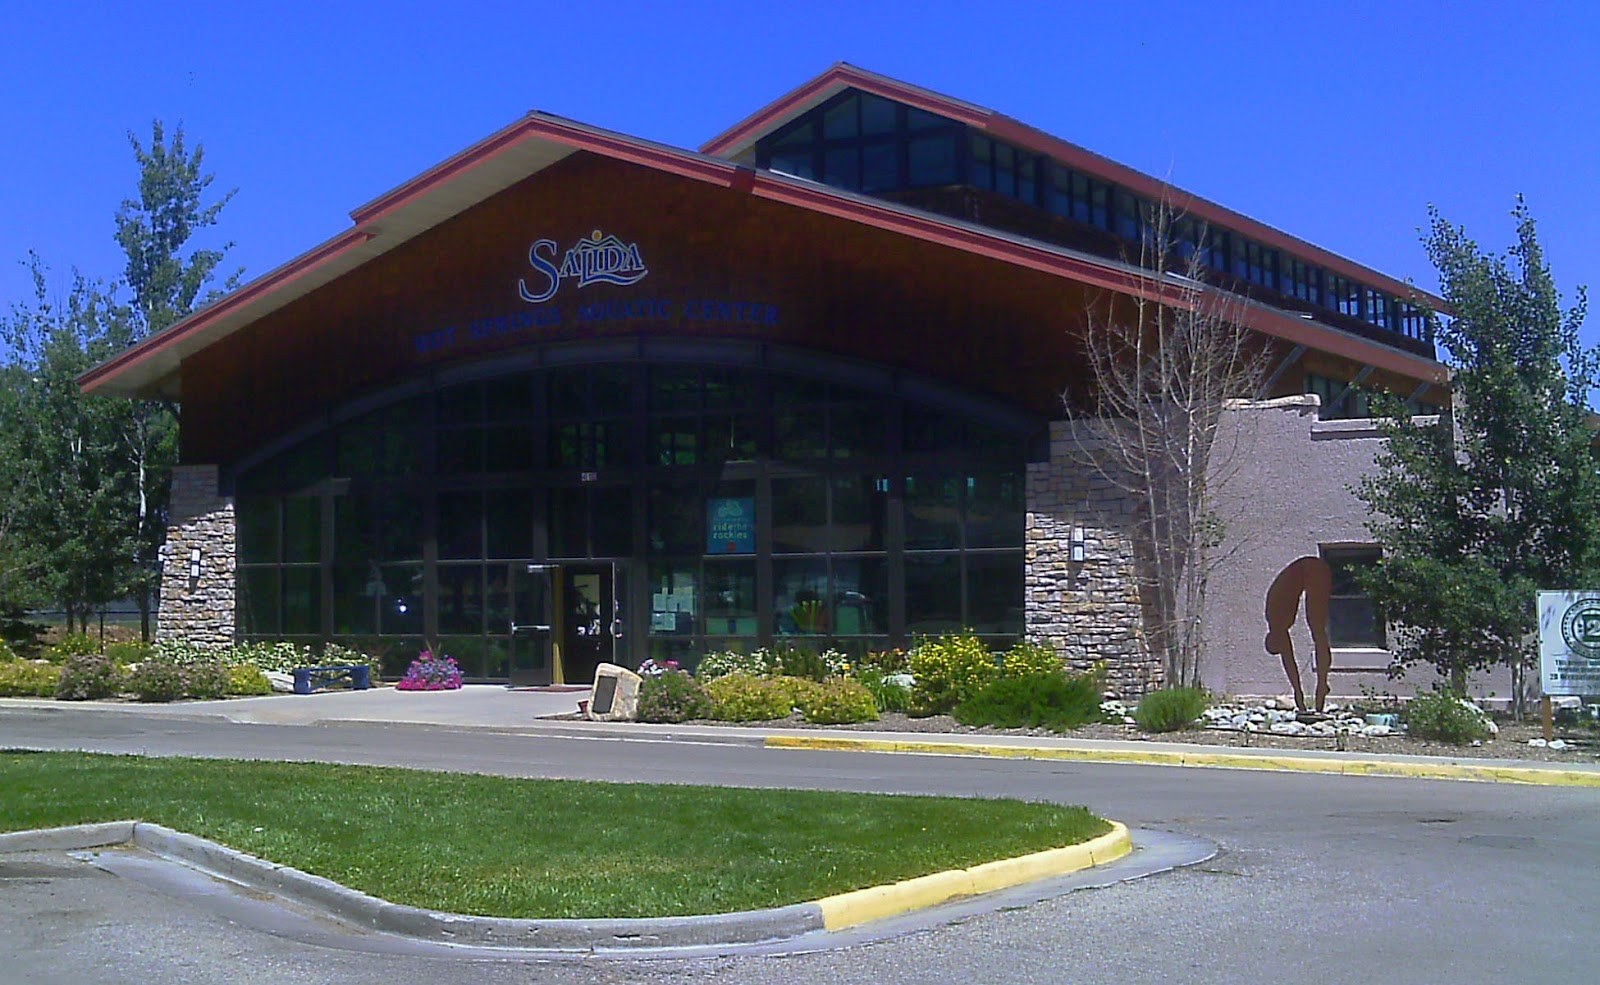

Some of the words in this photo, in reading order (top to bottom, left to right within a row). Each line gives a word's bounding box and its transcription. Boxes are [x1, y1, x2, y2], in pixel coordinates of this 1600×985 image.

[518, 234, 649, 303] SALIDA
[415, 326, 457, 353] HOT
[470, 306, 562, 340] SPRINGS
[577, 300, 671, 323] AQUATIC
[685, 301, 780, 326] CENTER
